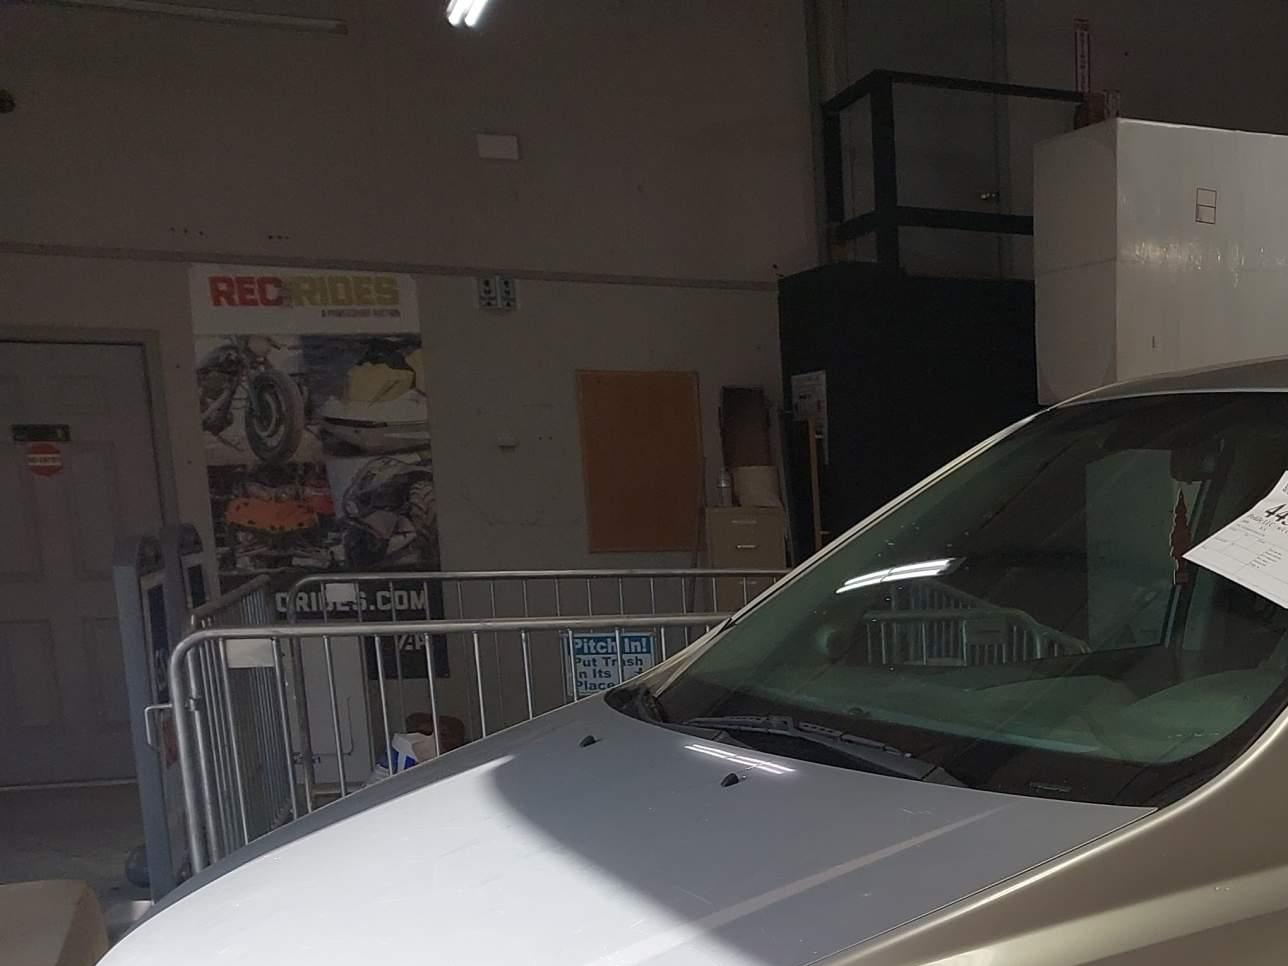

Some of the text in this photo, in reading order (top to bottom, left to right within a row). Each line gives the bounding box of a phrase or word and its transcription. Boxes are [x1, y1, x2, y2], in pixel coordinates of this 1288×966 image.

[575, 637, 648, 653] Pitch In!
[575, 657, 597, 667] Put
[593, 669, 611, 678] Its
[576, 680, 616, 691] Place
